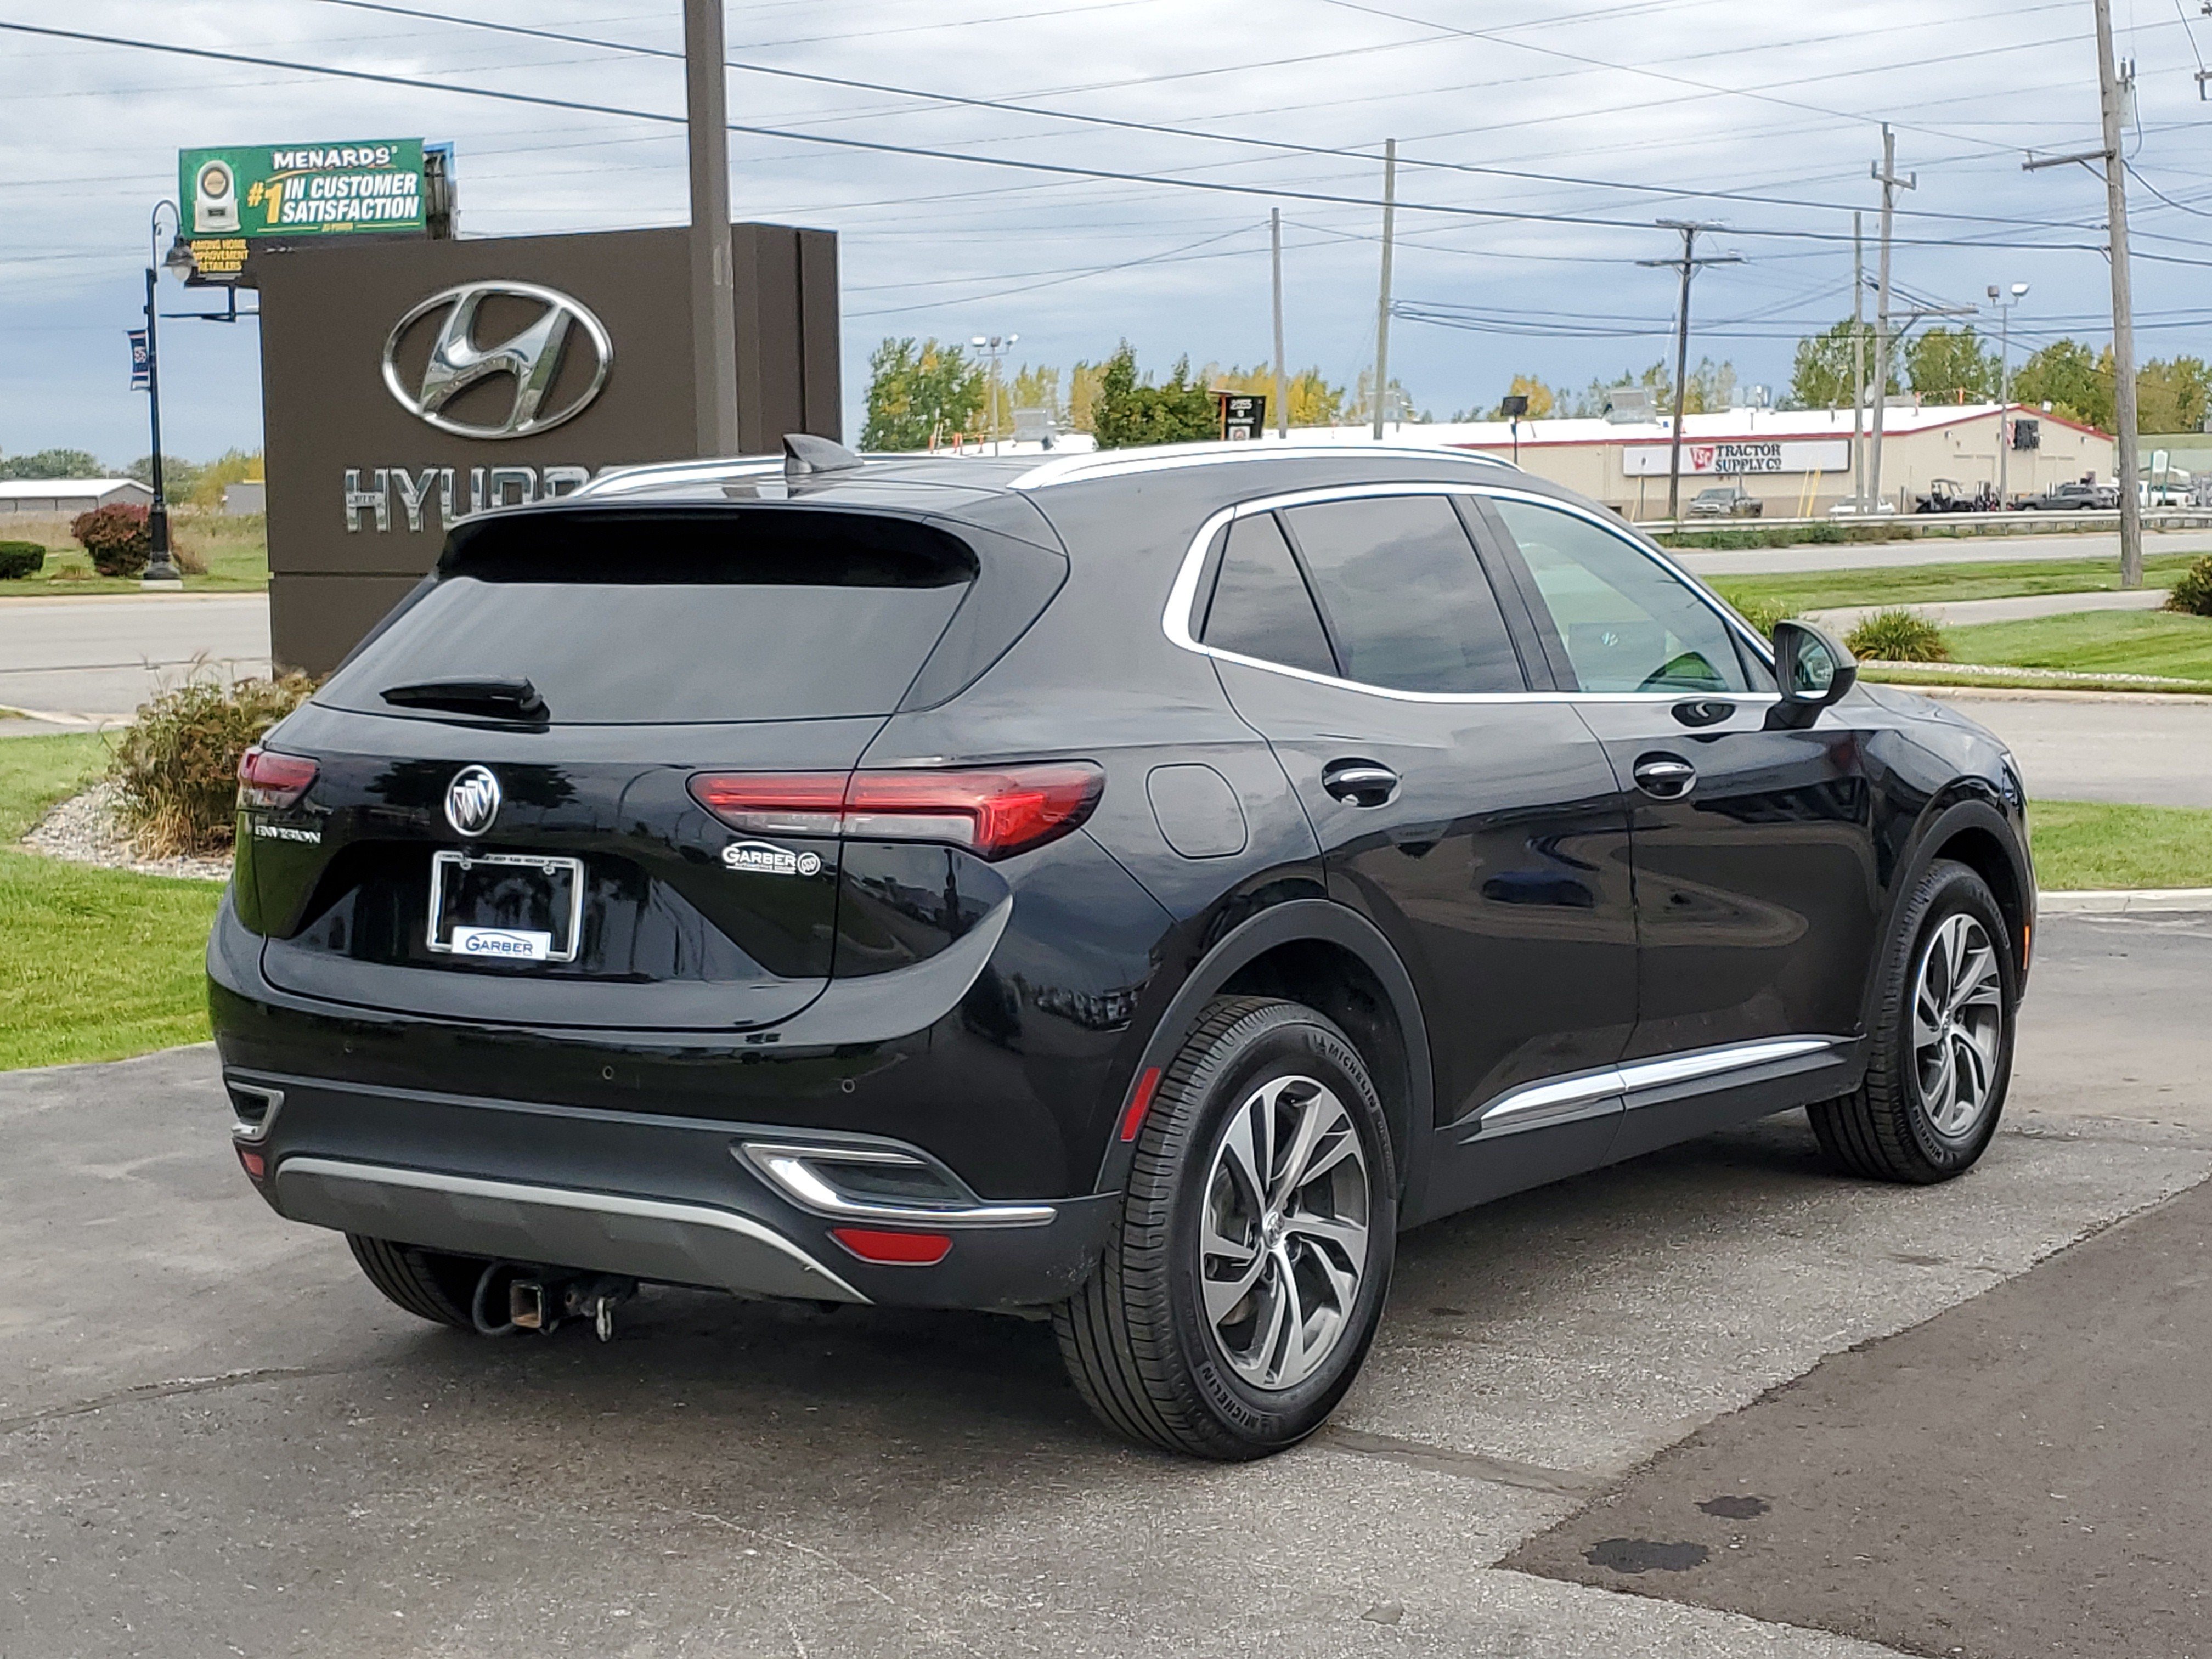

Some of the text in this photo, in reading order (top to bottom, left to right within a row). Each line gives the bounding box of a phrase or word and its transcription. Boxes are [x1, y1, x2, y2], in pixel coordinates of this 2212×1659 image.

[273, 146, 391, 170] MENARDS
[247, 172, 419, 224] #1 IN CUSTOMER
[281, 195, 420, 224] SATISFACTION
[1716, 444, 1781, 457] TRACTOR
[1715, 458, 1765, 472] SUPPLY
[721, 846, 796, 867] GARBER
[465, 935, 533, 955] GARBER
[1328, 1042, 1378, 1108] MICHELIN
[1201, 1367, 1260, 1429] MICHELIN
